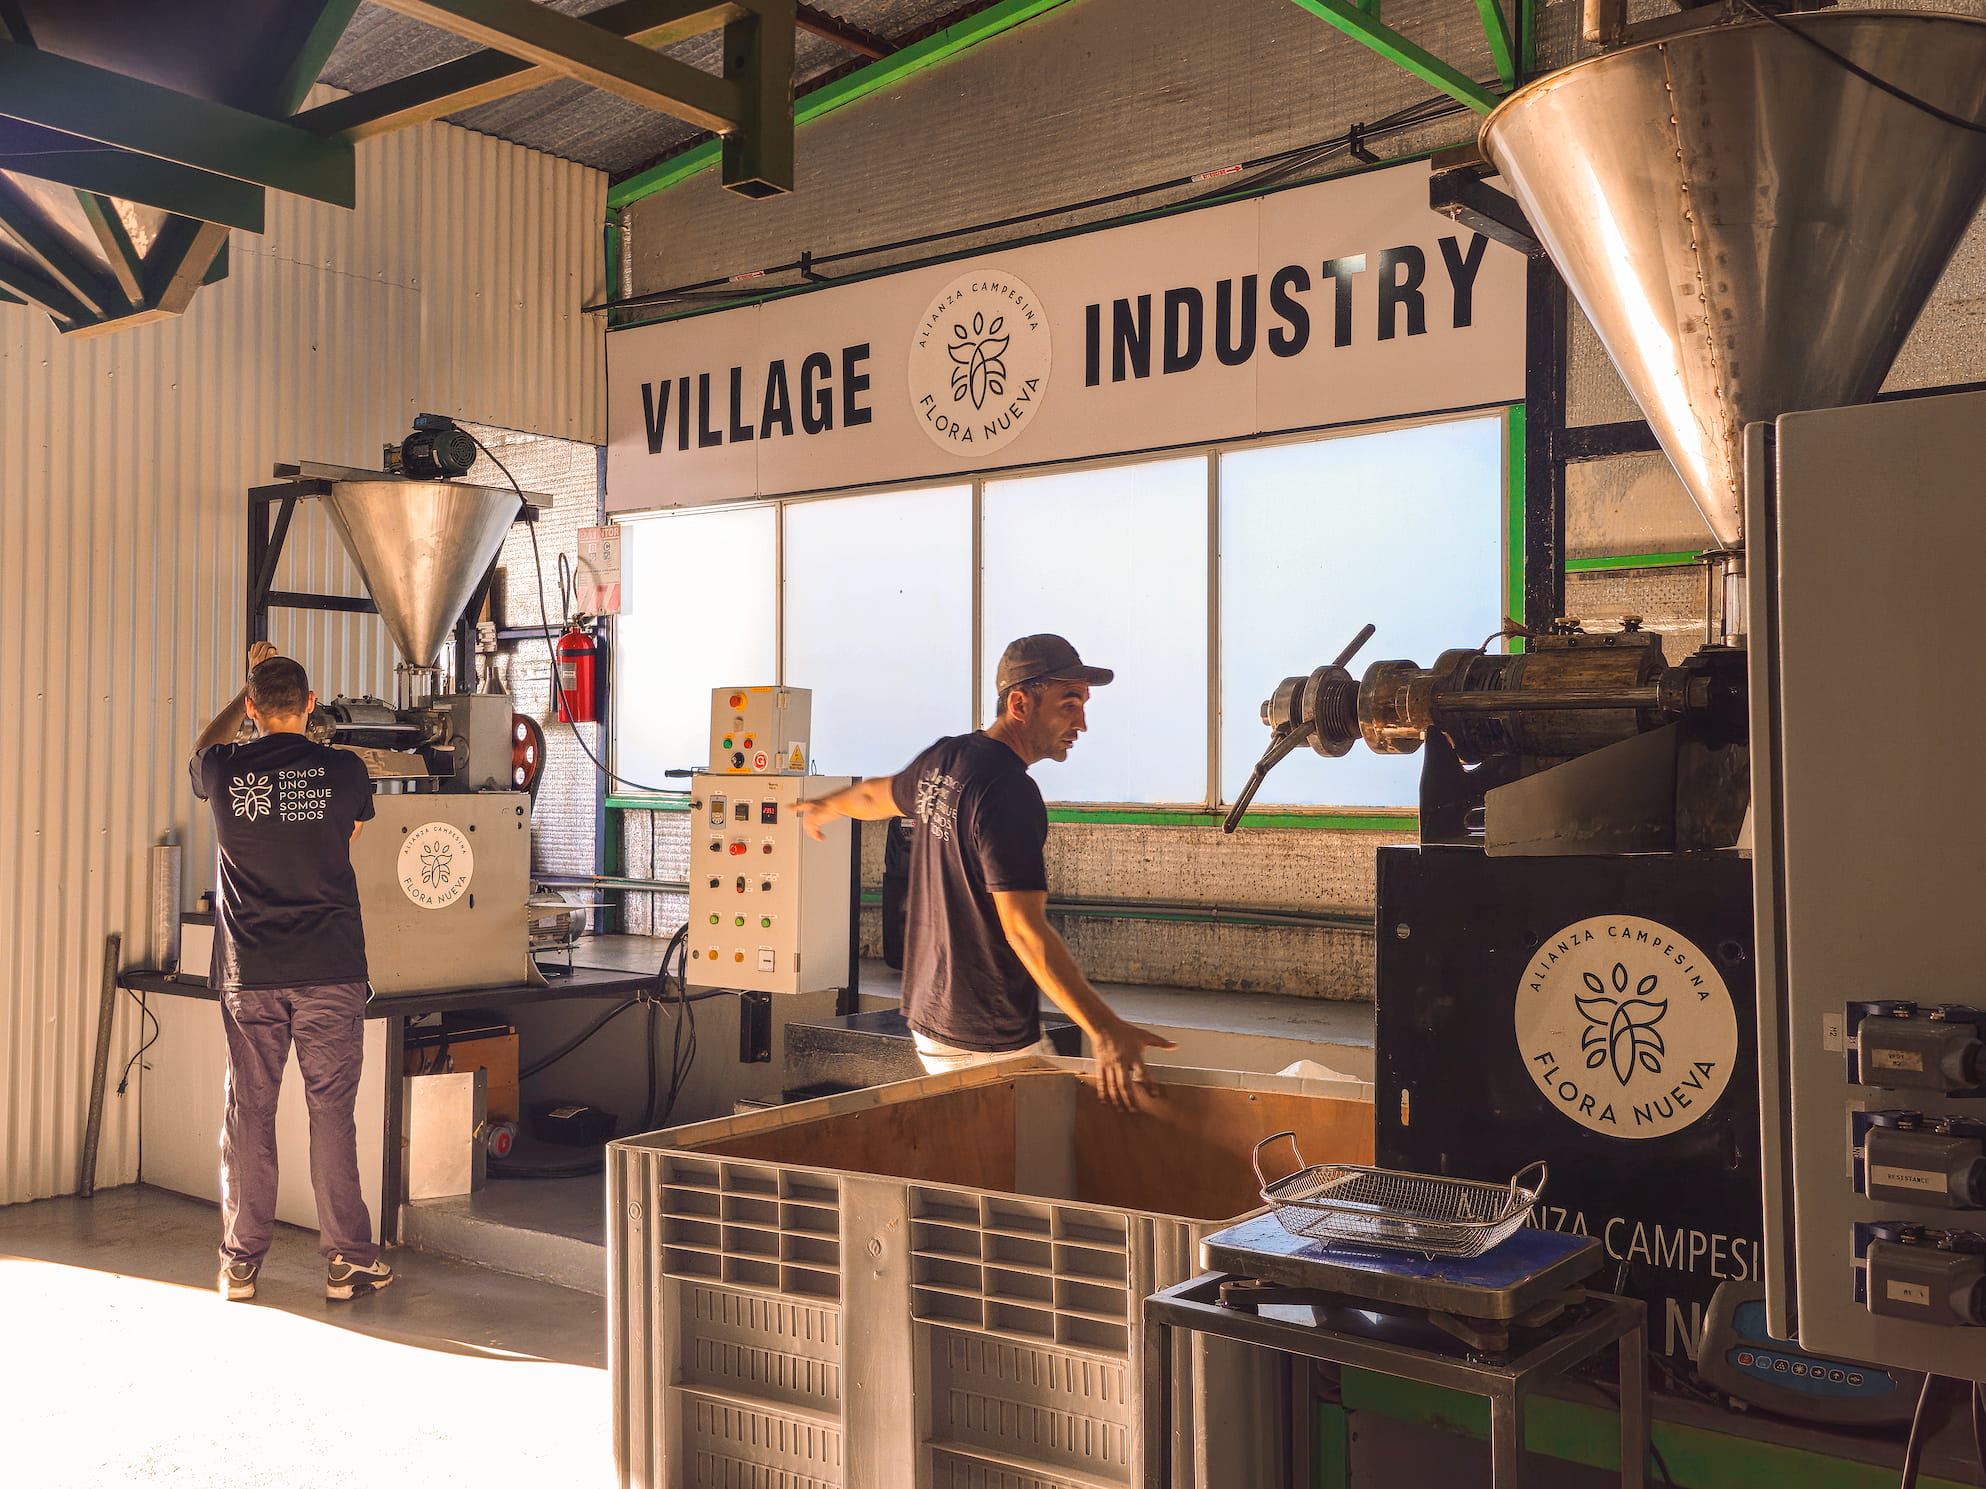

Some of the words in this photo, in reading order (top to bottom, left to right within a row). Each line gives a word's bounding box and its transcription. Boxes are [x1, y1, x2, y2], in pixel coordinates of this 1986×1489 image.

[918, 289, 964, 349] ALIANZA
[971, 281, 1039, 333] CAMPESINA
[641, 343, 872, 455] VILLAGE
[1085, 232, 1489, 387] INDUSTRY
[919, 392, 974, 443] FLORA
[984, 375, 1040, 441] NUEVA
[278, 767, 325, 780] SOMOS
[279, 779, 308, 790] UNO
[279, 788, 332, 801] PORQUE
[279, 799, 327, 811] SOMOS
[280, 810, 324, 822] TODOS
[404, 828, 430, 854] ALIANZA
[433, 826, 467, 854] CAMPESINA
[403, 877, 433, 905] FLORA
[438, 876, 467, 904] NUEVA
[1530, 930, 1594, 993] ALIANZA
[1607, 926, 1710, 1001] CAMPESINA
[1533, 1051, 1617, 1125] FLORA
[1632, 1062, 1716, 1126] NUEVA
[1604, 1216, 1759, 1282] CAMPESI
